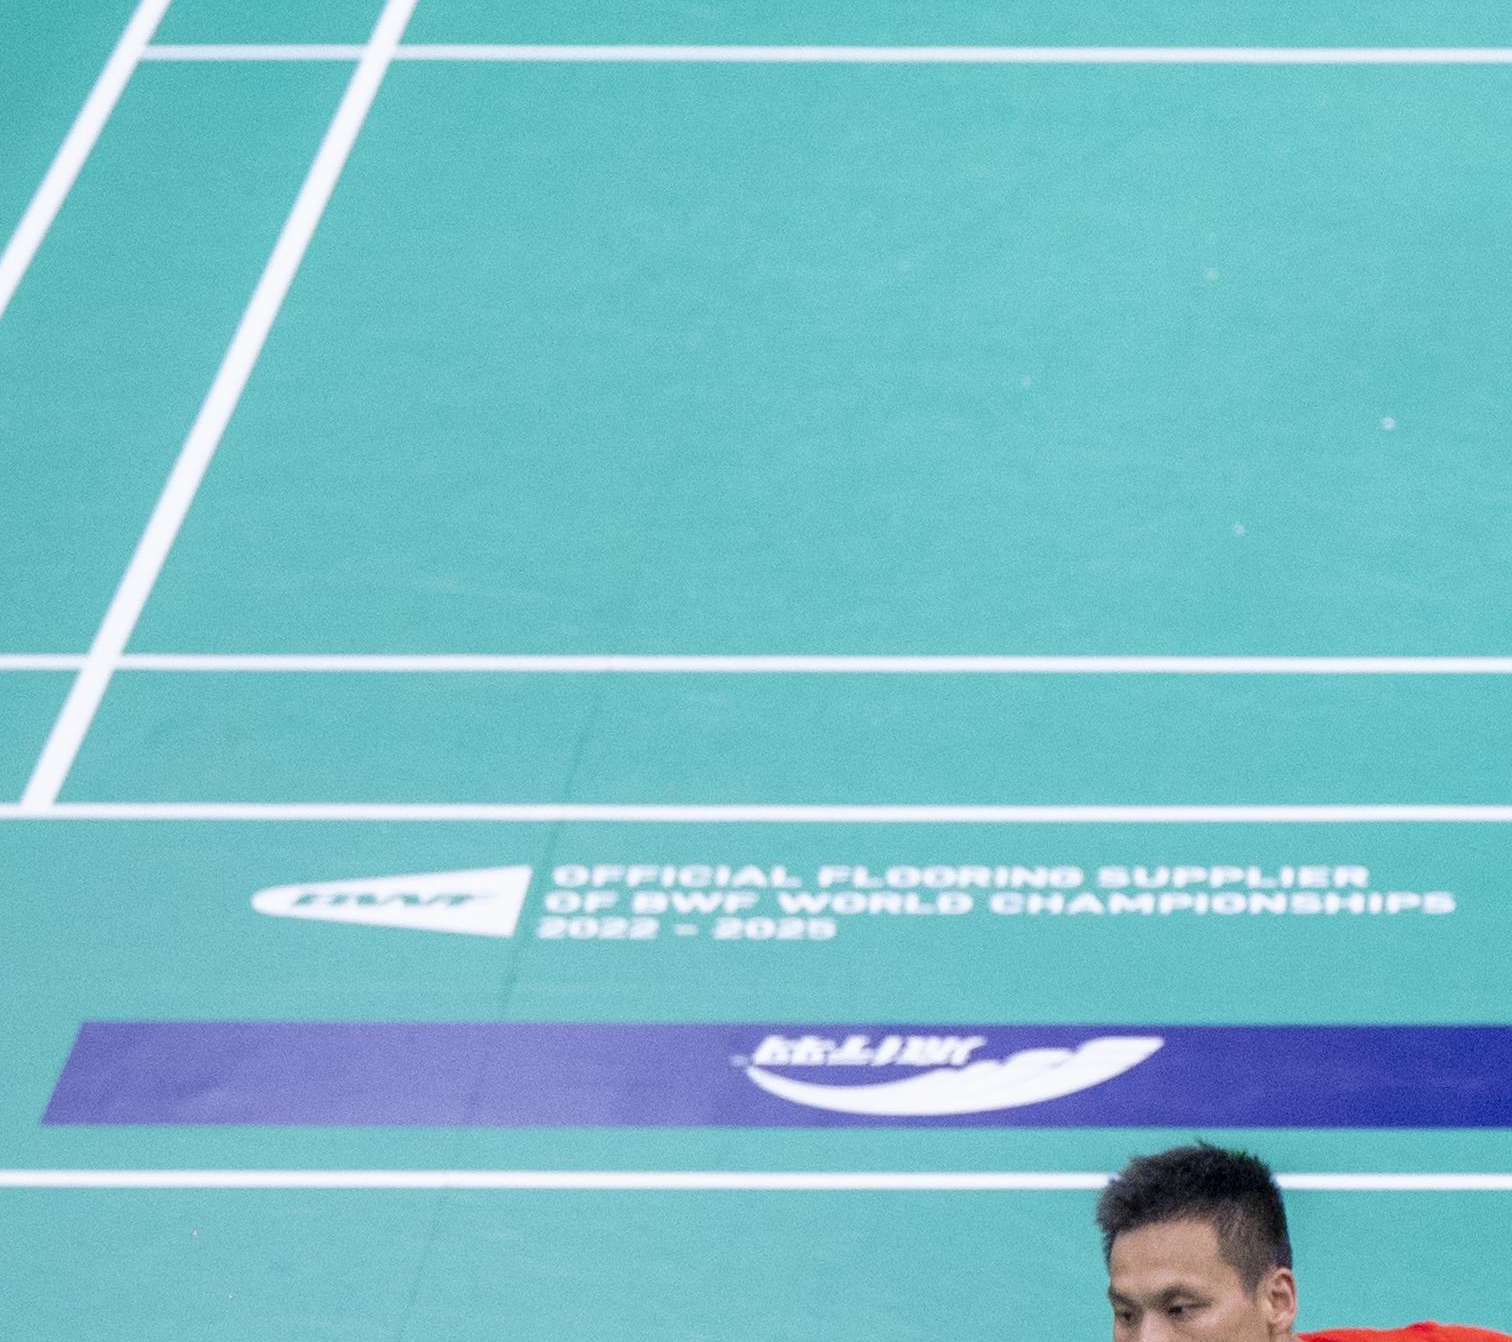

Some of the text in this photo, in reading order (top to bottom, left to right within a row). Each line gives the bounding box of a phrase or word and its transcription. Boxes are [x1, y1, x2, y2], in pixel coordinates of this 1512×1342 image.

[552, 864, 1370, 889] OFFICIAL FLOORING SUPPLIER
[544, 890, 1457, 915] OF BWF WORLD CHAMPIONSHIPS
[536, 915, 659, 940] 2022
[711, 915, 838, 940] 2025
